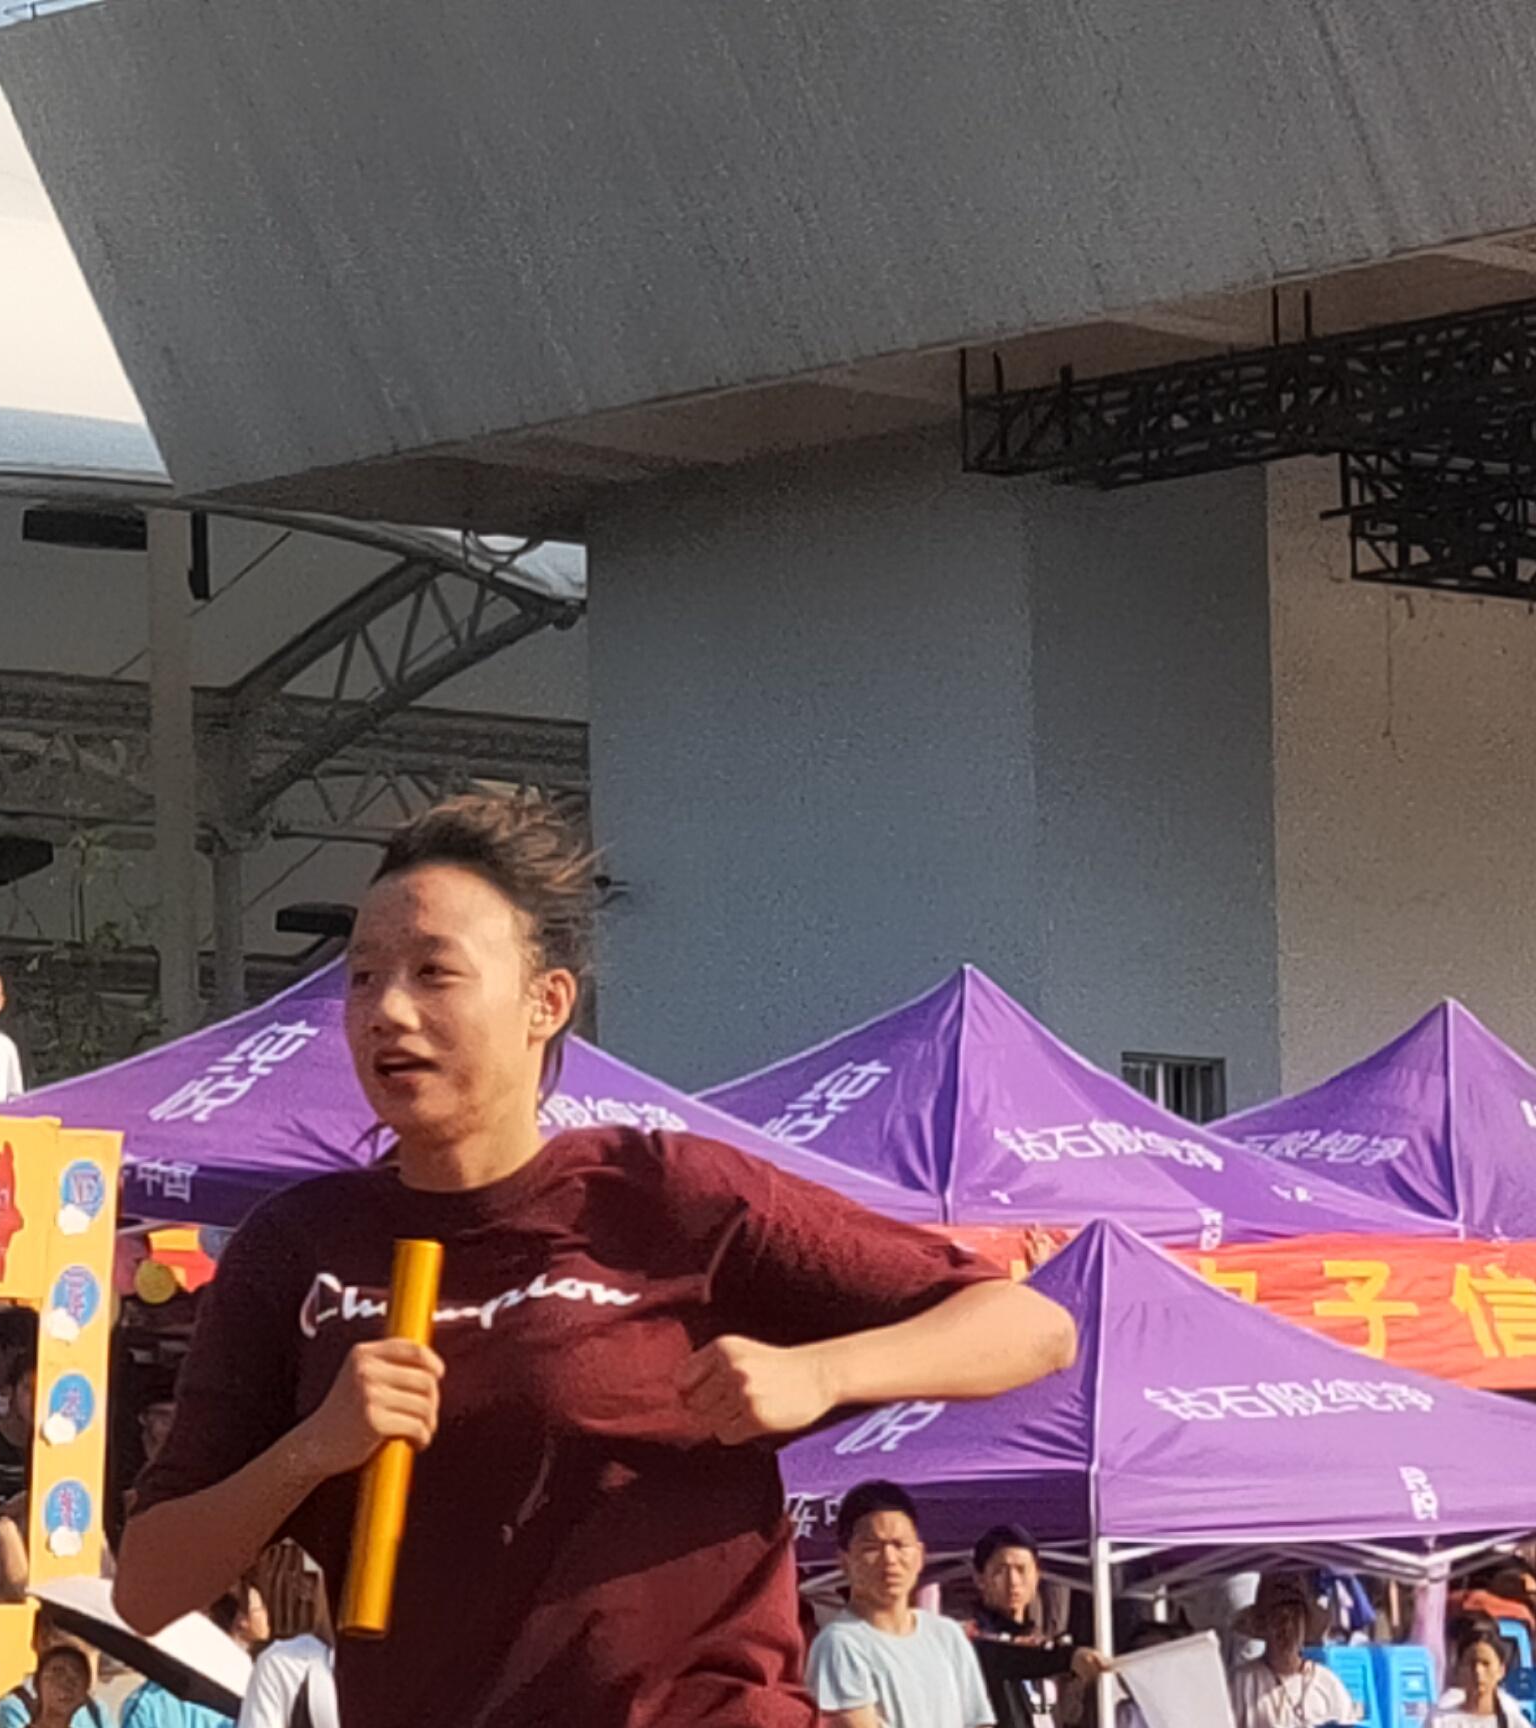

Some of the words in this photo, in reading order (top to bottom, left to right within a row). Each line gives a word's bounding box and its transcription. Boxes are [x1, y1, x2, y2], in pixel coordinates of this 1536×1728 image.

[993, 1120, 1223, 1172] 钻石般纯净
[1142, 1379, 1434, 1420] 钻石般纯净
